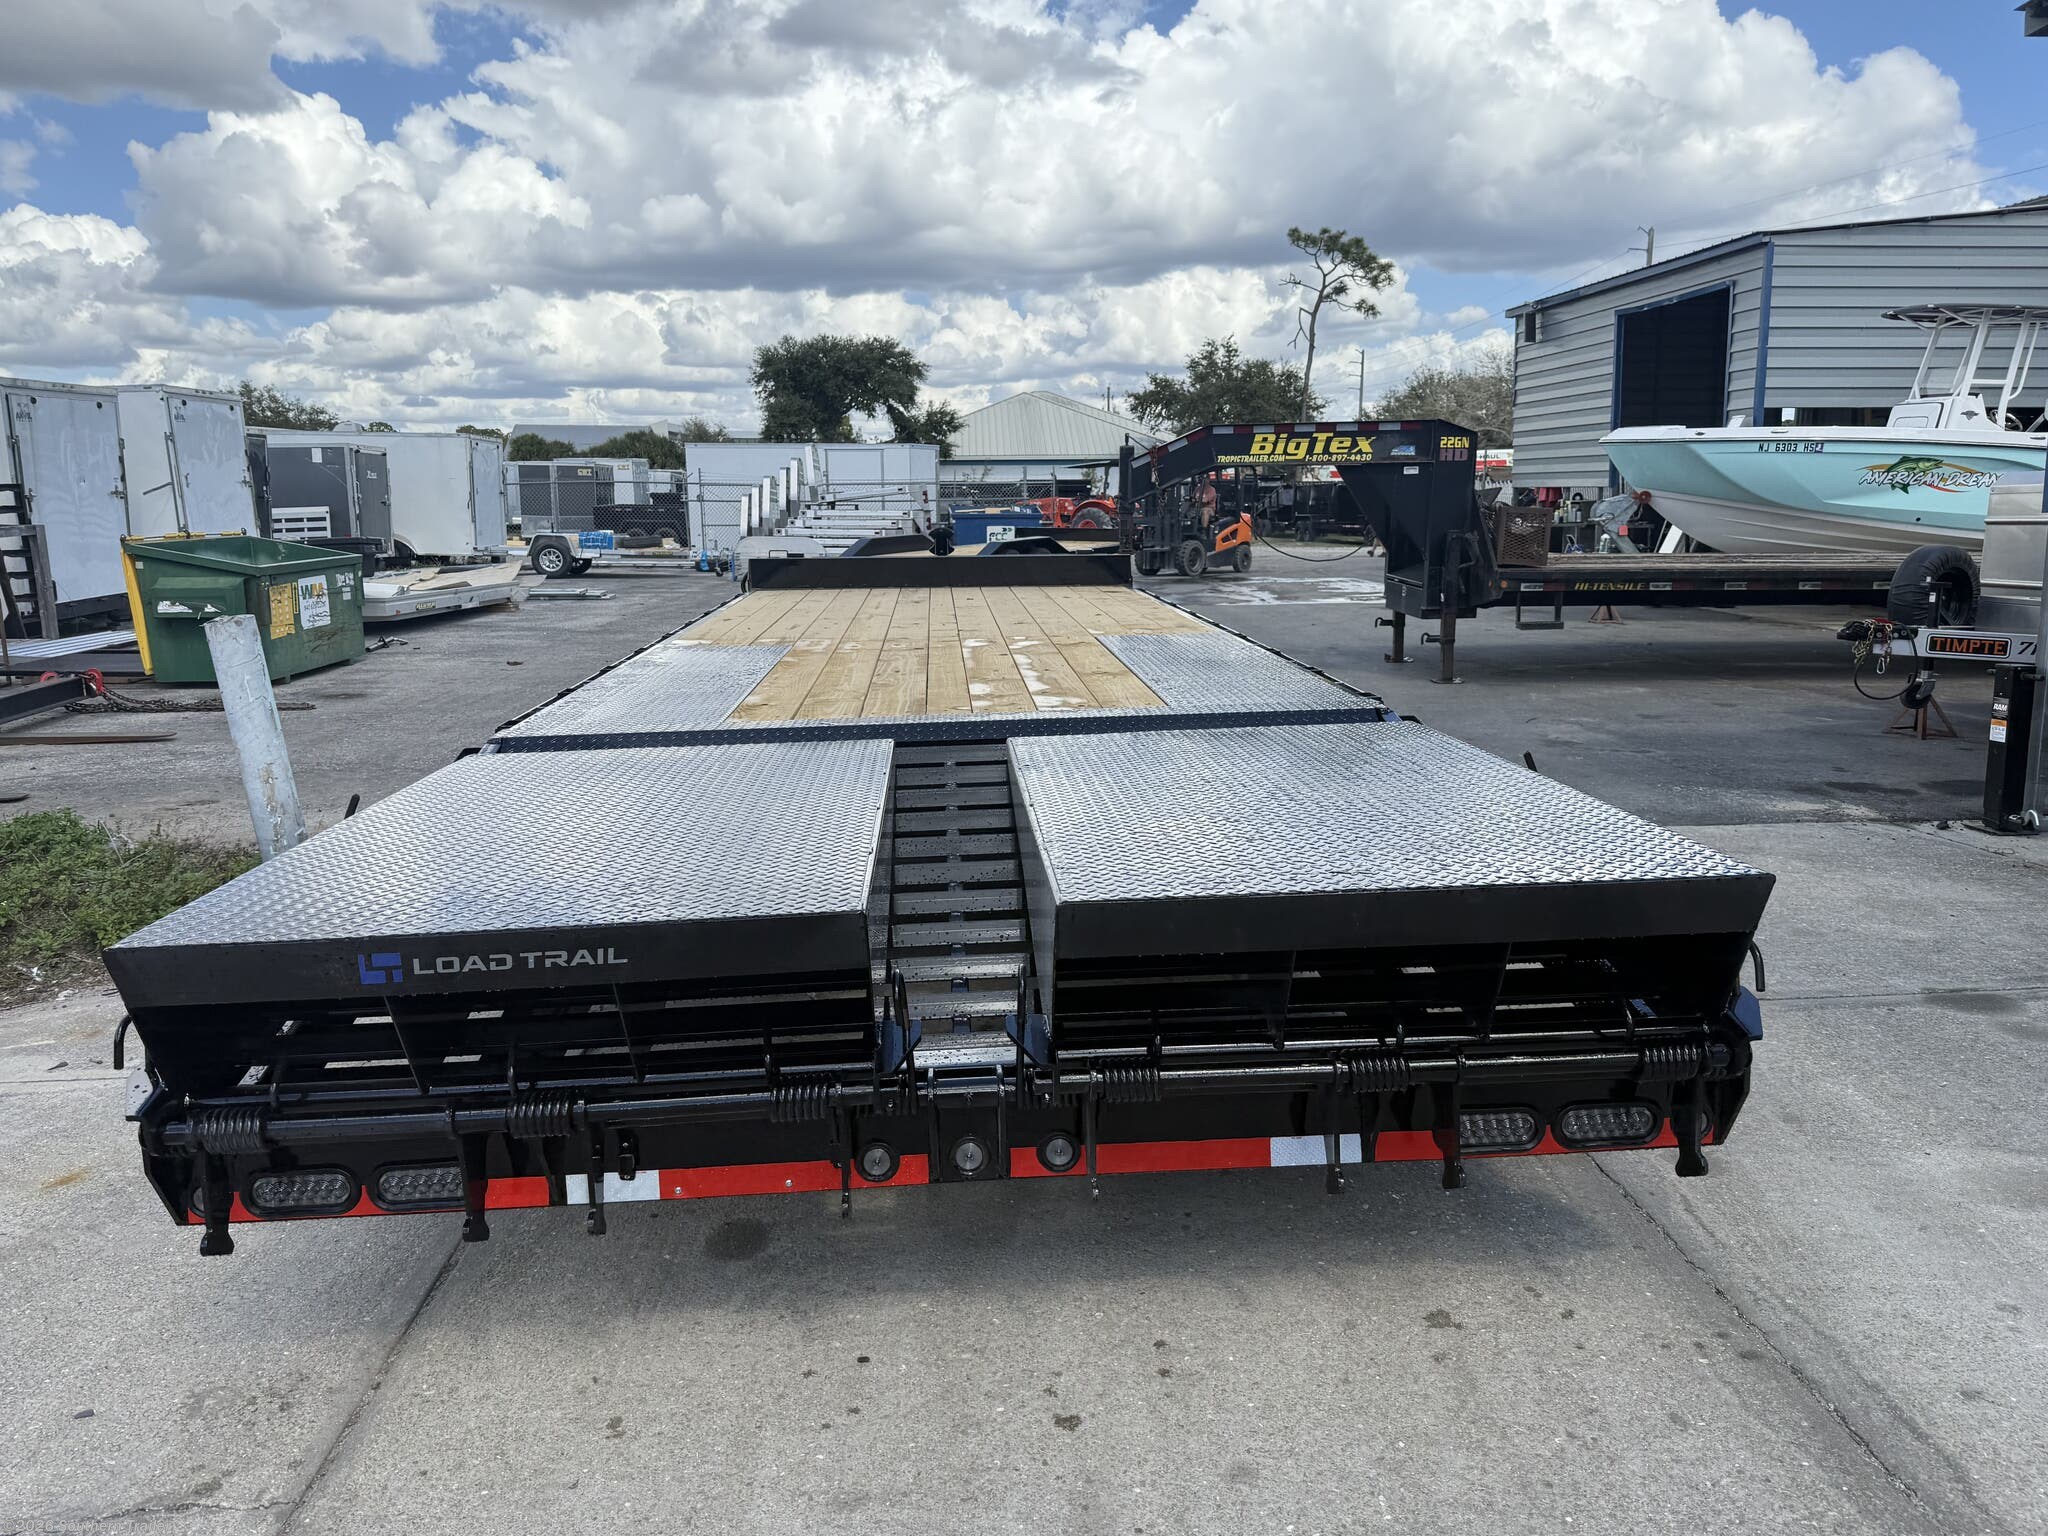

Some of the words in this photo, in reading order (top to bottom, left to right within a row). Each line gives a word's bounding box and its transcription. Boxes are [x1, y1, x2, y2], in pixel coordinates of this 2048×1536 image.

[1250, 432, 1376, 460] BigTex
[1758, 442, 1770, 452] NJ
[1775, 442, 1798, 452] 6303
[1803, 442, 1815, 452] HS
[1217, 455, 1285, 463] TROPICTRAILER.COM
[1305, 454, 1372, 462] 1-800-897-4430
[1440, 449, 1468, 461] HD
[1859, 470, 1945, 488] AMERICAN
[1574, 582, 1646, 591] HI-TENSILE
[1933, 637, 2006, 655] TIMPTE
[1992, 703, 2008, 711] RAM
[412, 954, 513, 975] LOAD
[519, 948, 629, 968] TRAIL
